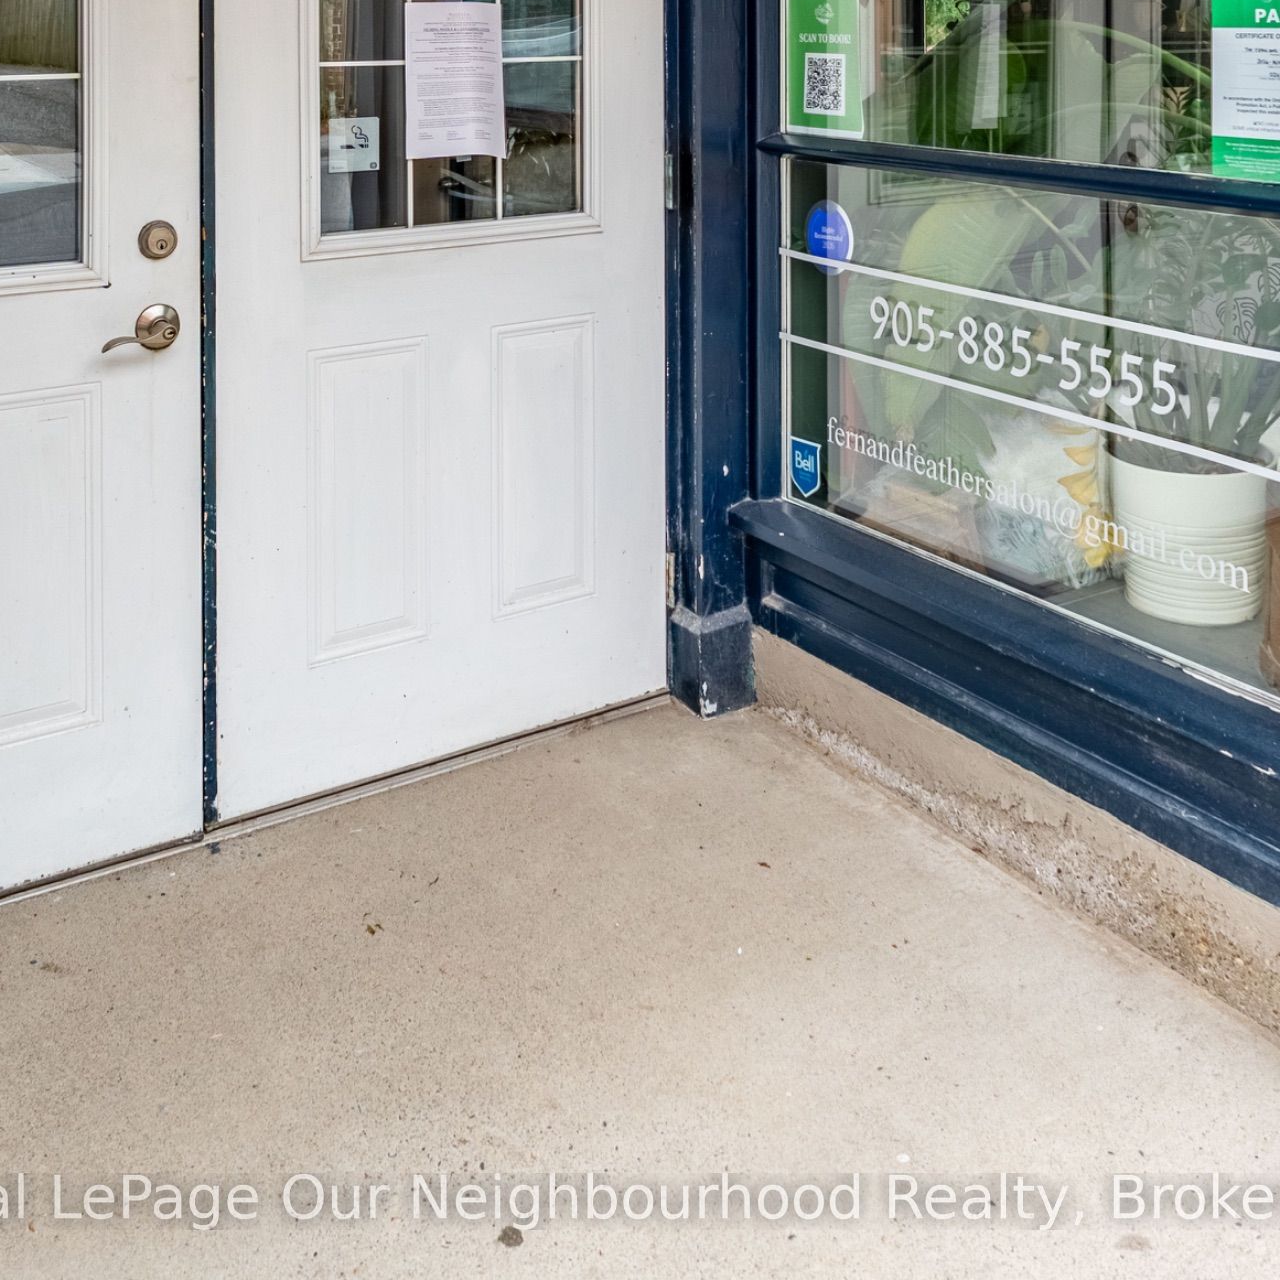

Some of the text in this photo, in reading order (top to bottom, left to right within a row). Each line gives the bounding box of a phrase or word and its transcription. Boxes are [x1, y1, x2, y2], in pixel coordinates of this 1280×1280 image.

[798, 33, 852, 44] SCAN TO BOOK!
[869, 295, 1177, 416] 905-885-5555
[795, 450, 815, 473] Bell
[826, 416, 1251, 595] fernandfeathersalon@gmail.com
